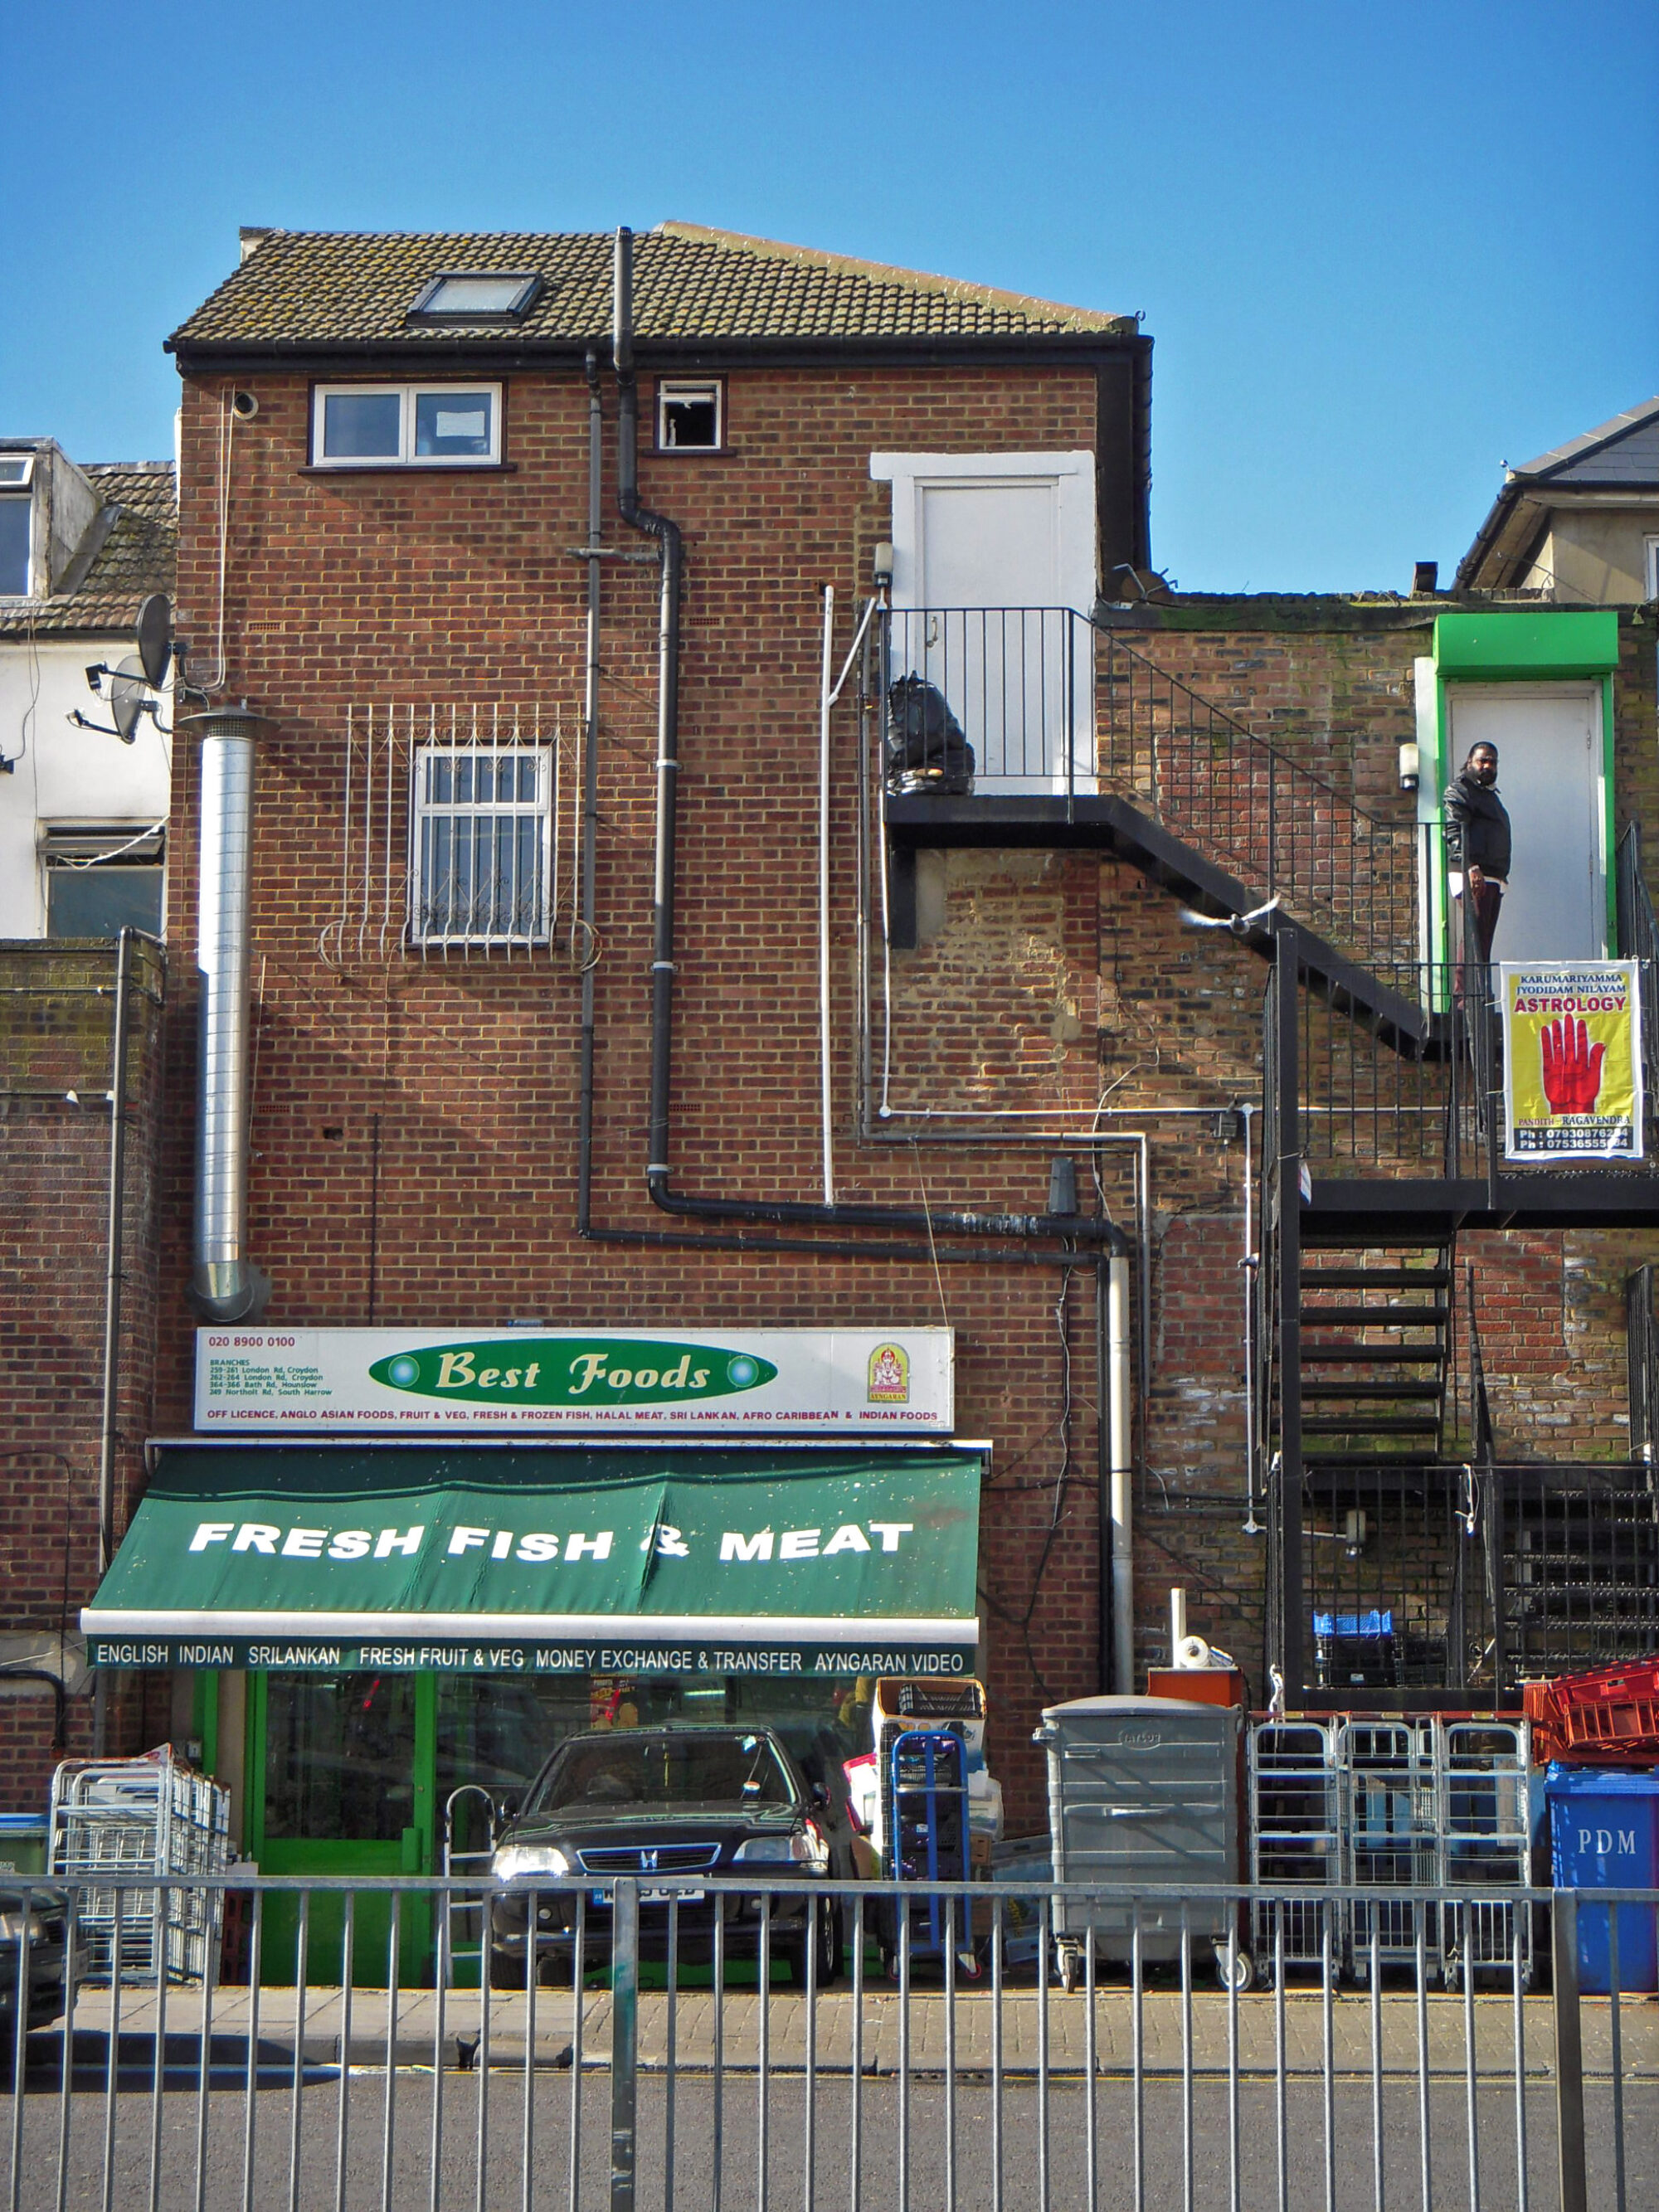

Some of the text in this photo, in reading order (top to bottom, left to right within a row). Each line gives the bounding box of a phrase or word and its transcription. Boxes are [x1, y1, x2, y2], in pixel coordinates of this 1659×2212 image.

[1520, 974, 1623, 984] KARUMARIYAMMA
[1516, 984, 1627, 995] JYODIDAM NILAYAM
[1515, 996, 1627, 1012] ASTROLOGY
[1519, 1117, 1554, 1126] PANDITH
[1562, 1116, 1631, 1125] RAGAVENDRA
[1520, 1129, 1535, 1139] Ph
[1520, 1140, 1536, 1149] Ph
[1546, 1139, 1628, 1149] 075365554
[208, 1336, 295, 1347] 020 8900 0100
[287, 1367, 319, 1375] Croydon
[435, 1351, 711, 1394] Best Foods
[292, 1374, 324, 1383] Croydon
[207, 1410, 227, 1419] OFF
[231, 1410, 278, 1420] LICENCE,
[280, 1410, 317, 1419] ANGLO
[321, 1410, 354, 1419] ASIAN
[358, 1410, 397, 1420] FOODS,
[400, 1411, 431, 1419] FRUIT
[445, 1411, 469, 1420] VEG,
[473, 1411, 508, 1419] FRESH
[521, 1411, 563, 1419] FROZEN
[566, 1412, 592, 1420] FISH,
[596, 1412, 631, 1420] HALAL
[635, 1412, 667, 1420] MEAT,
[669, 1412, 687, 1420] SRI
[742, 1412, 772, 1420] AFRO
[776, 1411, 839, 1420] CARIBBEAN
[859, 1412, 898, 1420] INDIAN
[900, 1412, 937, 1421] FOODS
[188, 1523, 913, 1562] FRESH FISH & MEAT
[97, 1645, 964, 1672] ENGLISH INDIAN SRILANKAN FRESH FRUIT & VEG MONEY EXCHANGE & TRANSFER AYNGARAN VIDEO
[1578, 1829, 1637, 1855] PDM
